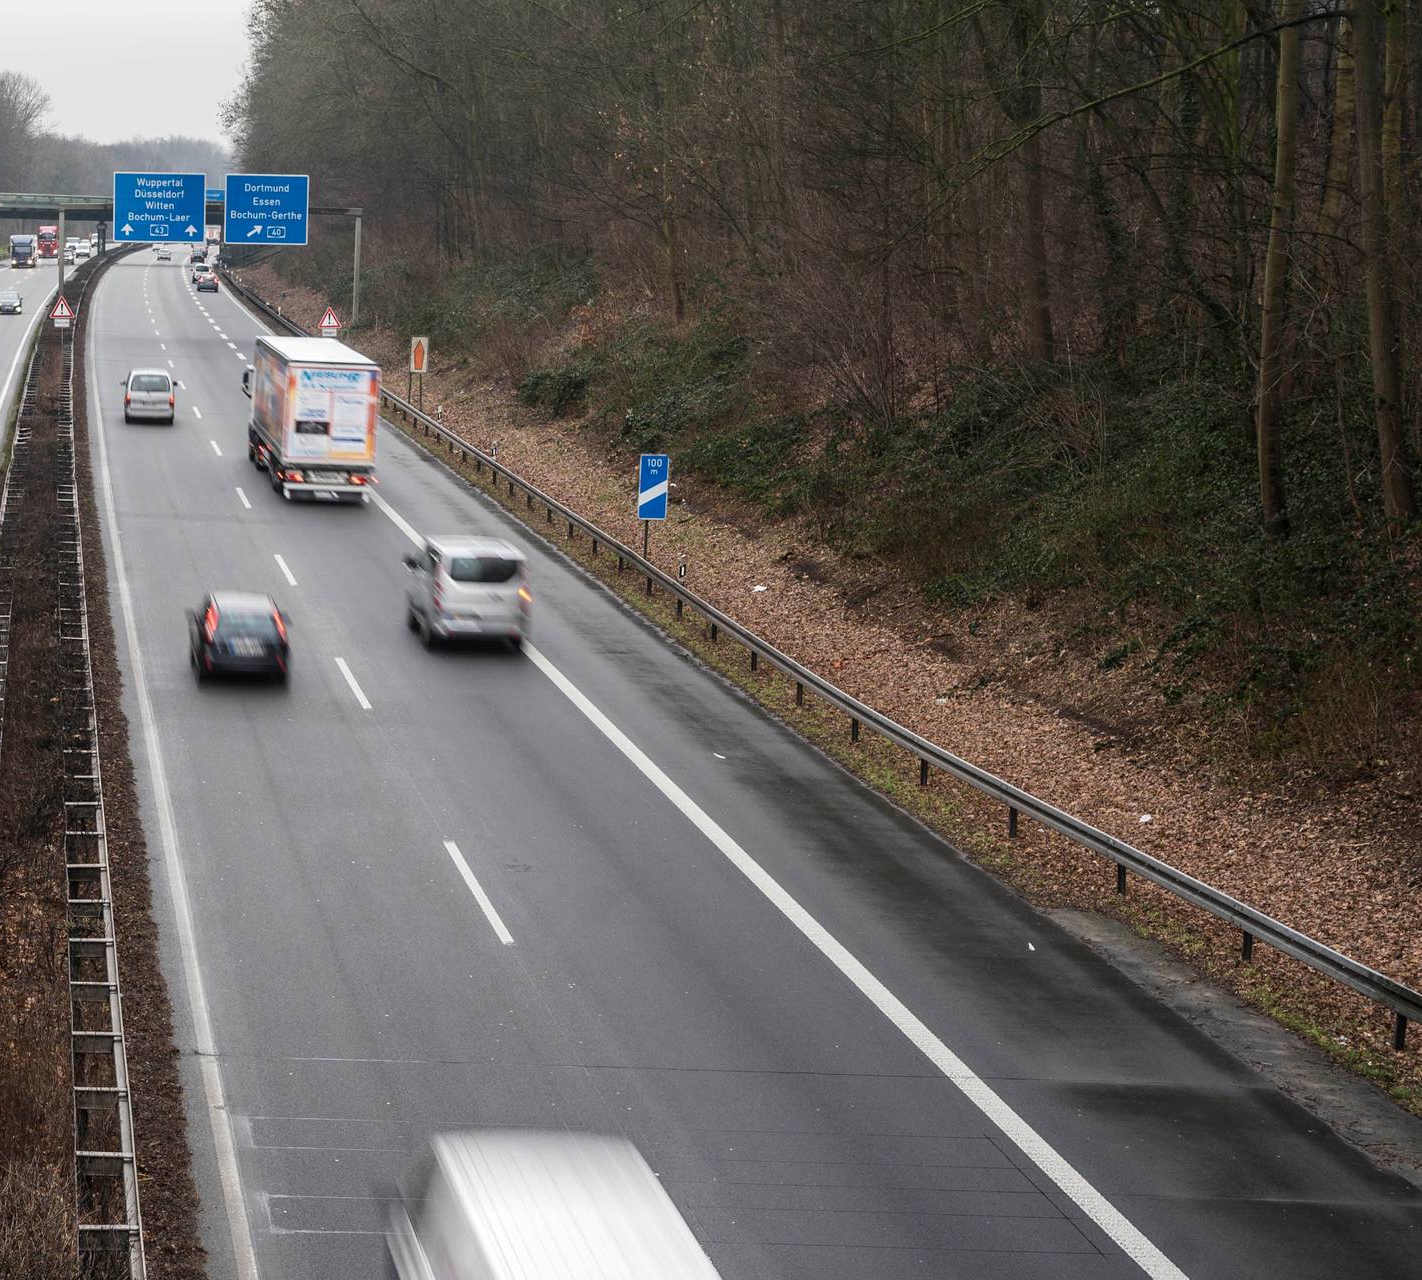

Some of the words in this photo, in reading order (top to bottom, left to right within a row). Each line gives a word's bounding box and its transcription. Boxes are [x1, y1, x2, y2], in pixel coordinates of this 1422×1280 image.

[136, 177, 183, 188] Wuppertal
[244, 183, 290, 193] Dortmund
[134, 189, 185, 199] Düsseldorf
[145, 201, 175, 210] Witten
[252, 196, 281, 206] Essen
[128, 212, 191, 222] Bochum-Laer
[230, 209, 303, 220] Bochum-Gerthe
[271, 228, 282, 236] 40
[647, 458, 663, 468] 100
